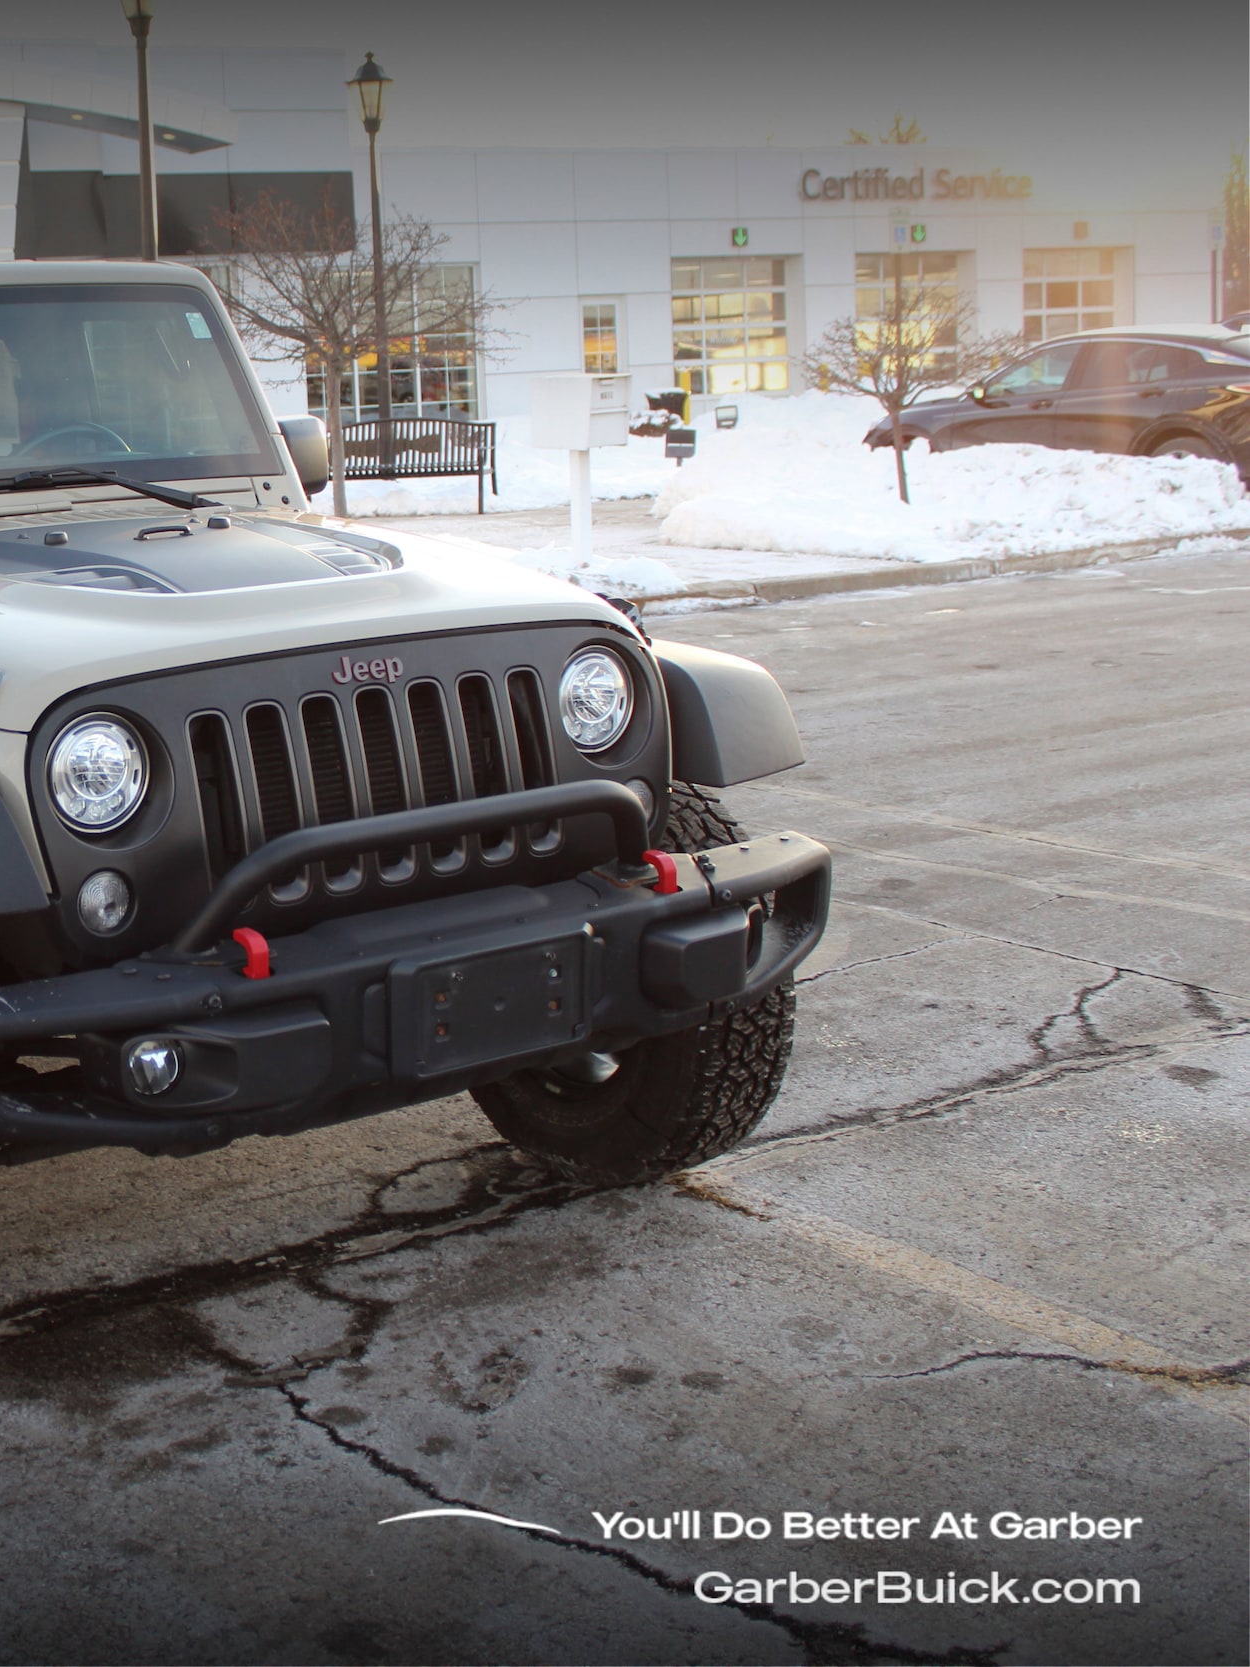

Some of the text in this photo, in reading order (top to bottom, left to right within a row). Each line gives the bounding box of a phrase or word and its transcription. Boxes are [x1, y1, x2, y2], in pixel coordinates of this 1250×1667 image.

[801, 167, 1033, 202] Certified Service
[332, 656, 404, 684] Jeep
